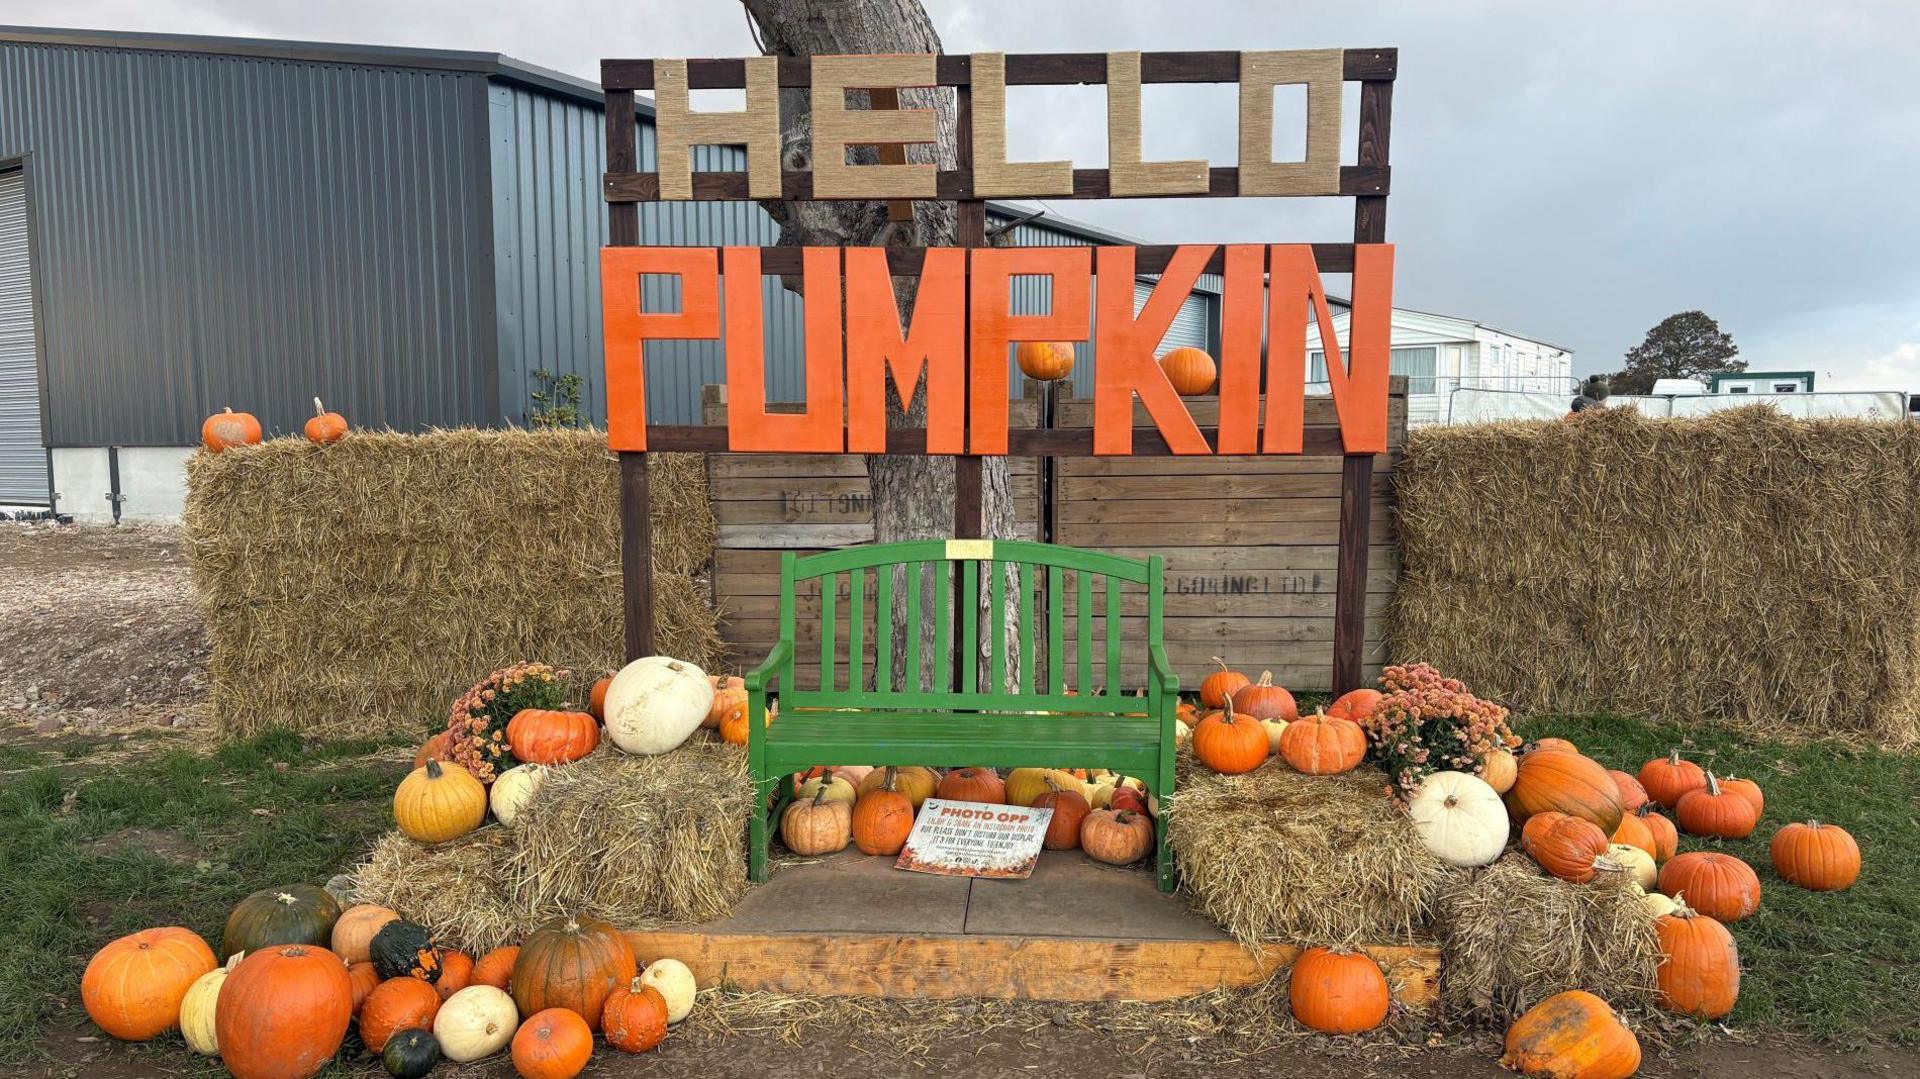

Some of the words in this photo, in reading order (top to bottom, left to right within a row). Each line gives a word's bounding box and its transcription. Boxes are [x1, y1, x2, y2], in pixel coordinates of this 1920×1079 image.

[653, 48, 1343, 201] HELLO
[600, 243, 1395, 456] PUMPKIN
[941, 807, 994, 820] PHOTO
[997, 812, 1030, 823] OPP
[933, 826, 953, 836] PLEASE
[954, 828, 972, 837] DON'T
[956, 838, 984, 848] EVERYONE
[986, 840, 995, 848] TO
[995, 841, 1015, 850] ENJOY
